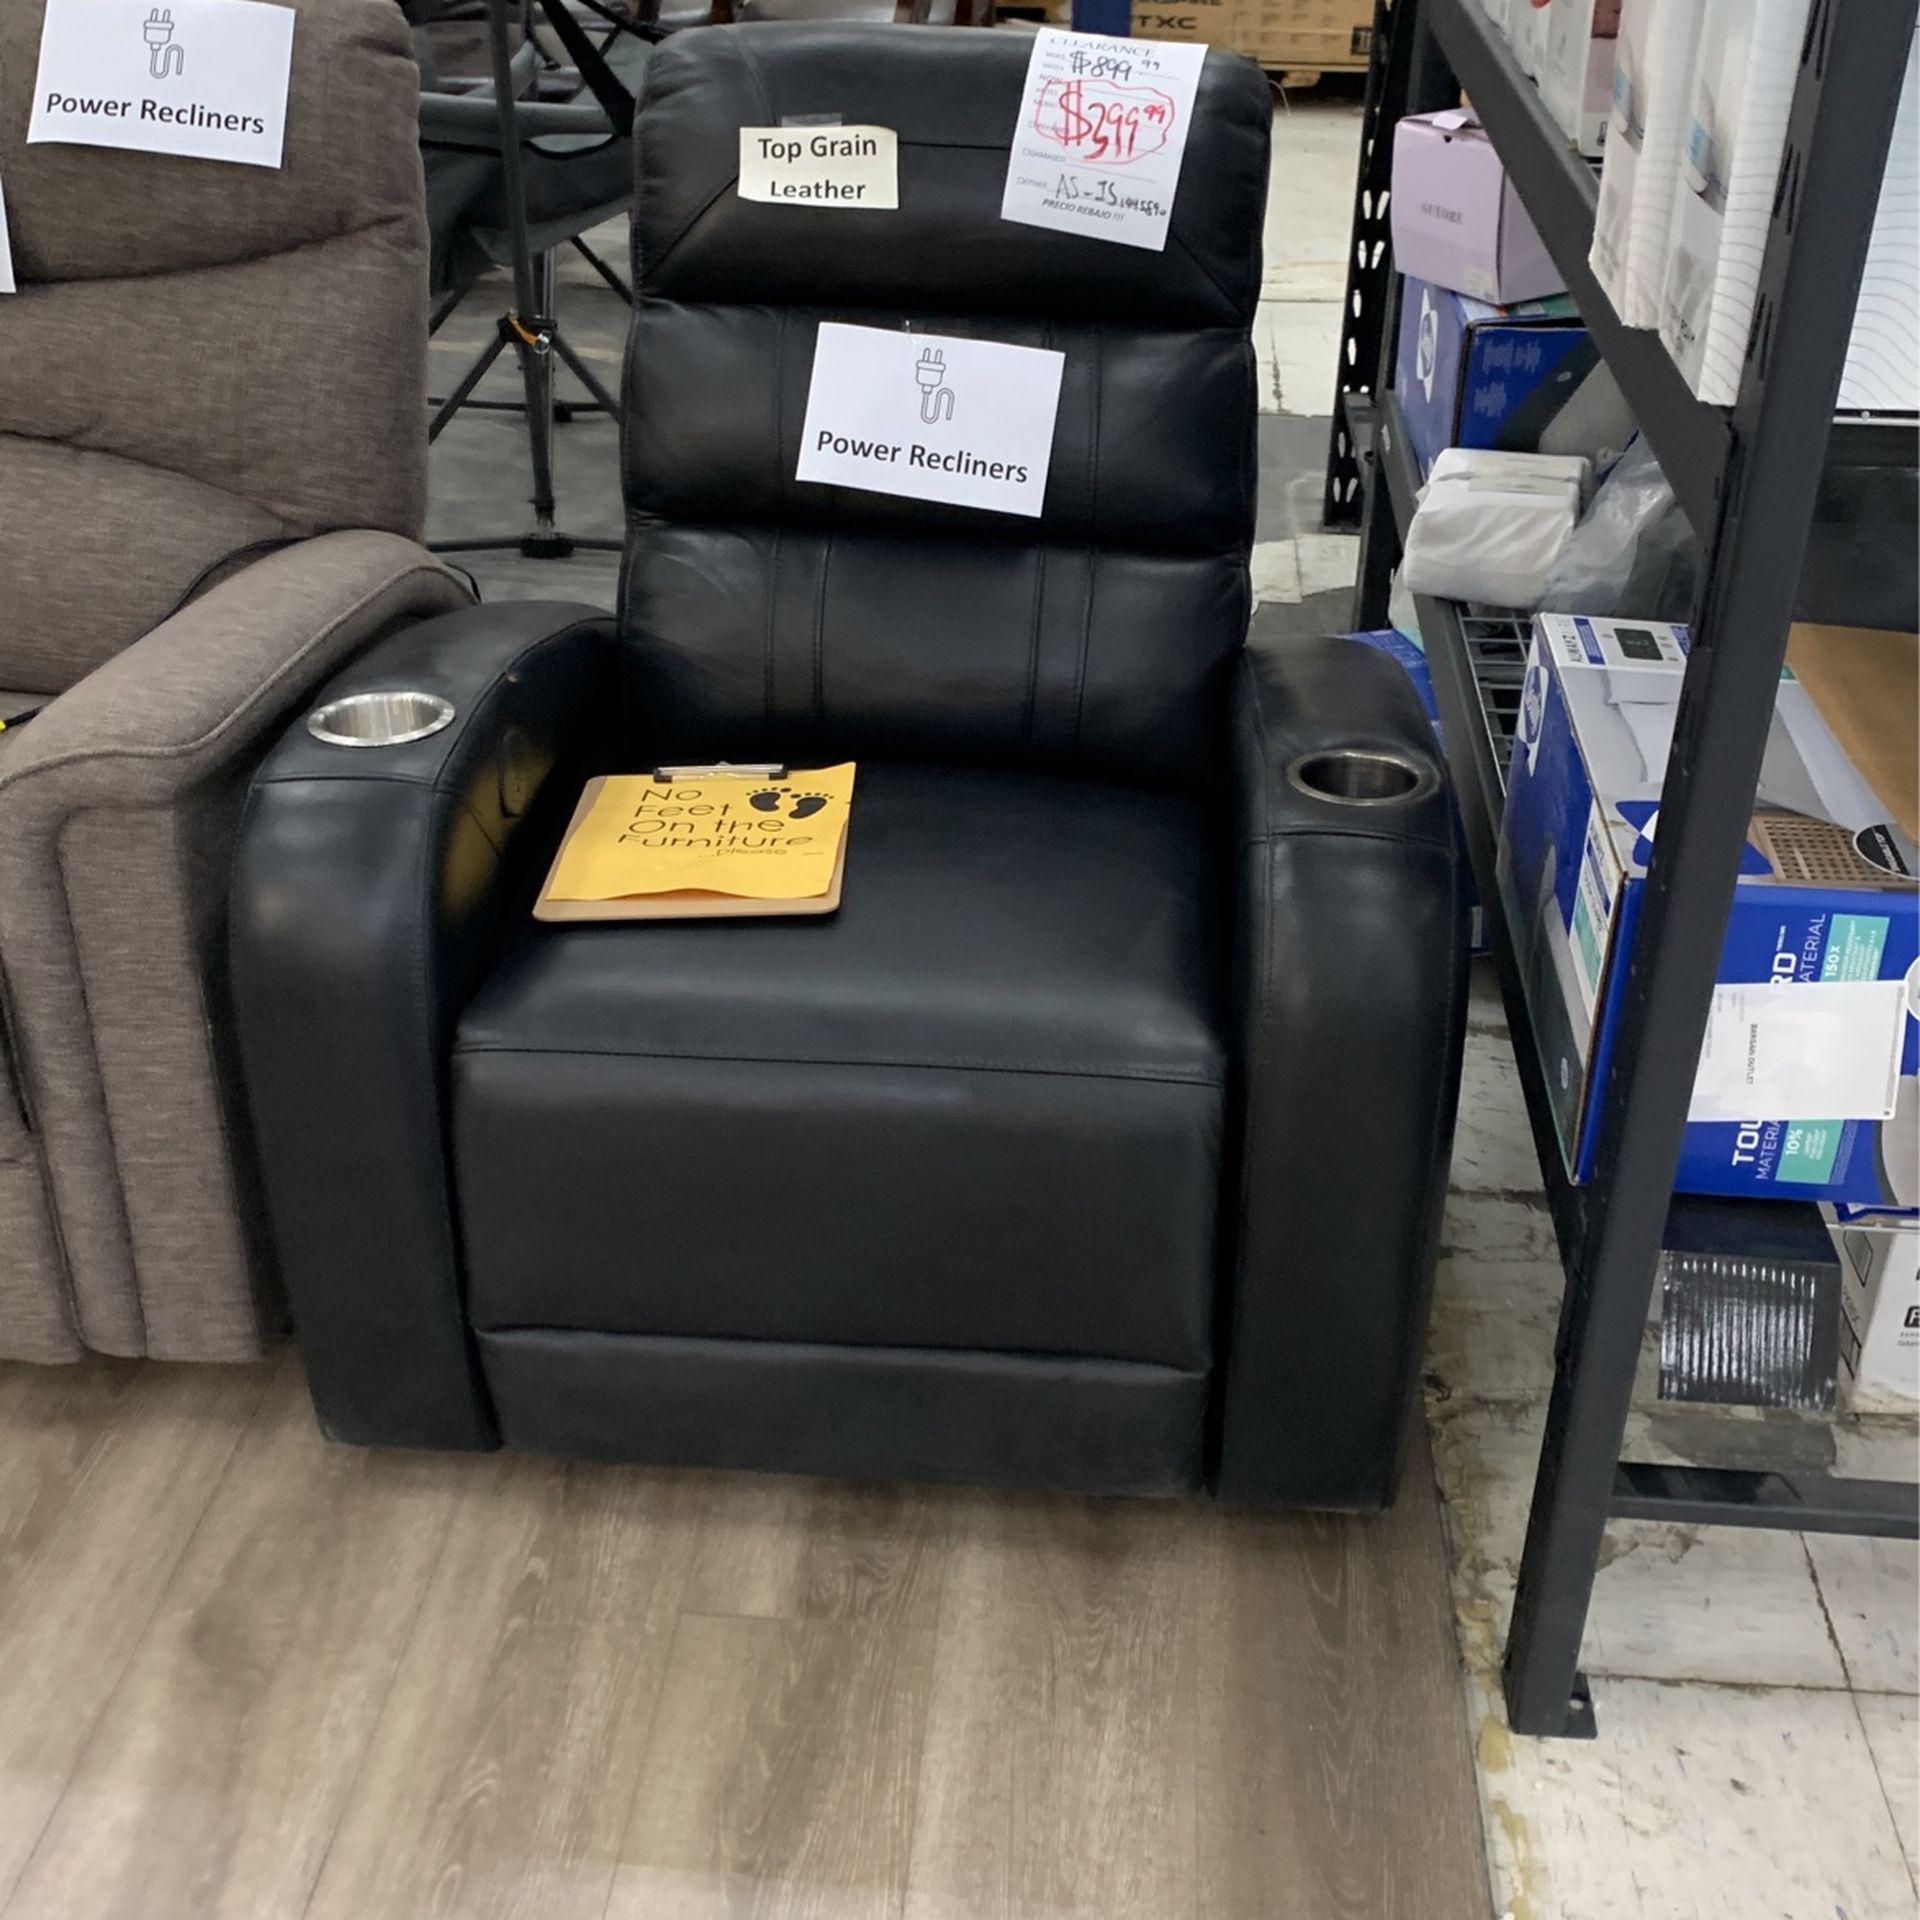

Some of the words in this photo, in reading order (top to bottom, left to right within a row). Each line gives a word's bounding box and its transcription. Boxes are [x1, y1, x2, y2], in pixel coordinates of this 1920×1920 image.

[1138, 15, 1197, 29] TXC
[1050, 37, 1153, 58] CLEARANCE
[1069, 50, 1132, 82] $899
[46, 93, 132, 118] Power
[140, 99, 265, 134] Recliners
[758, 138, 802, 164] Top
[810, 134, 877, 158] Grain
[771, 179, 867, 199] Leather
[1042, 198, 1075, 212] PRECIO
[1077, 206, 1111, 219] REBAJO
[817, 430, 902, 462] Power
[909, 444, 1028, 483] Recliners
[641, 788, 703, 802] No
[634, 803, 733, 818] Feet
[628, 819, 694, 833] On
[715, 819, 785, 833] the
[618, 833, 814, 848] Furniture
[1798, 913, 1827, 984] ATERIAL
[1786, 1128, 1803, 1157] 10%
